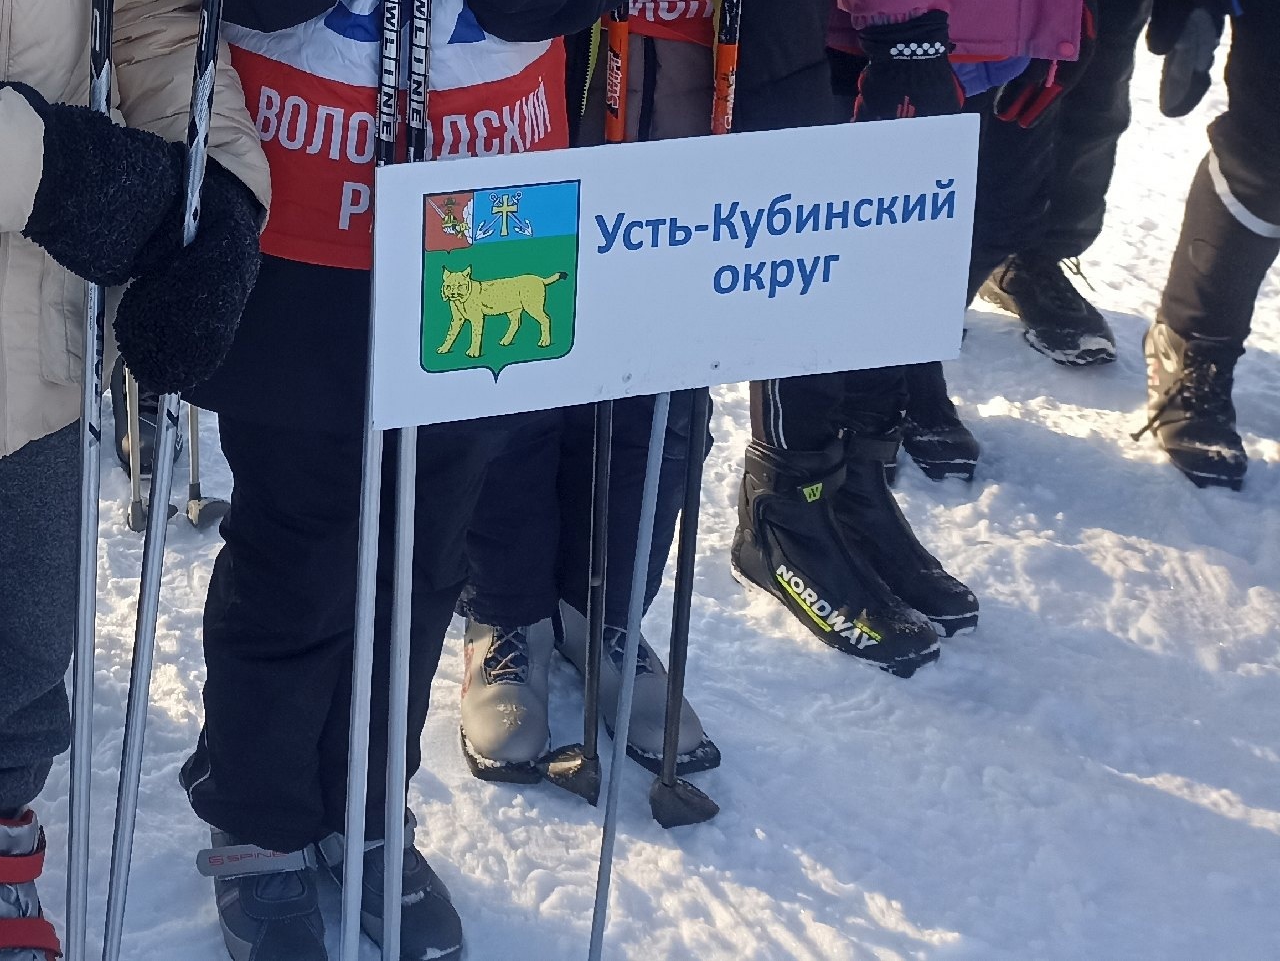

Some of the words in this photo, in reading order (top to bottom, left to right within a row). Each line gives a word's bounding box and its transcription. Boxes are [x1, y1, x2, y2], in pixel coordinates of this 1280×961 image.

[606, 49, 622, 109] SWIFT
[256, 77, 551, 164] ВОЛОДСКИЙ
[595, 179, 956, 254] Усть-Кубинский
[713, 254, 840, 298] округ
[776, 564, 879, 650] NORDWAY
